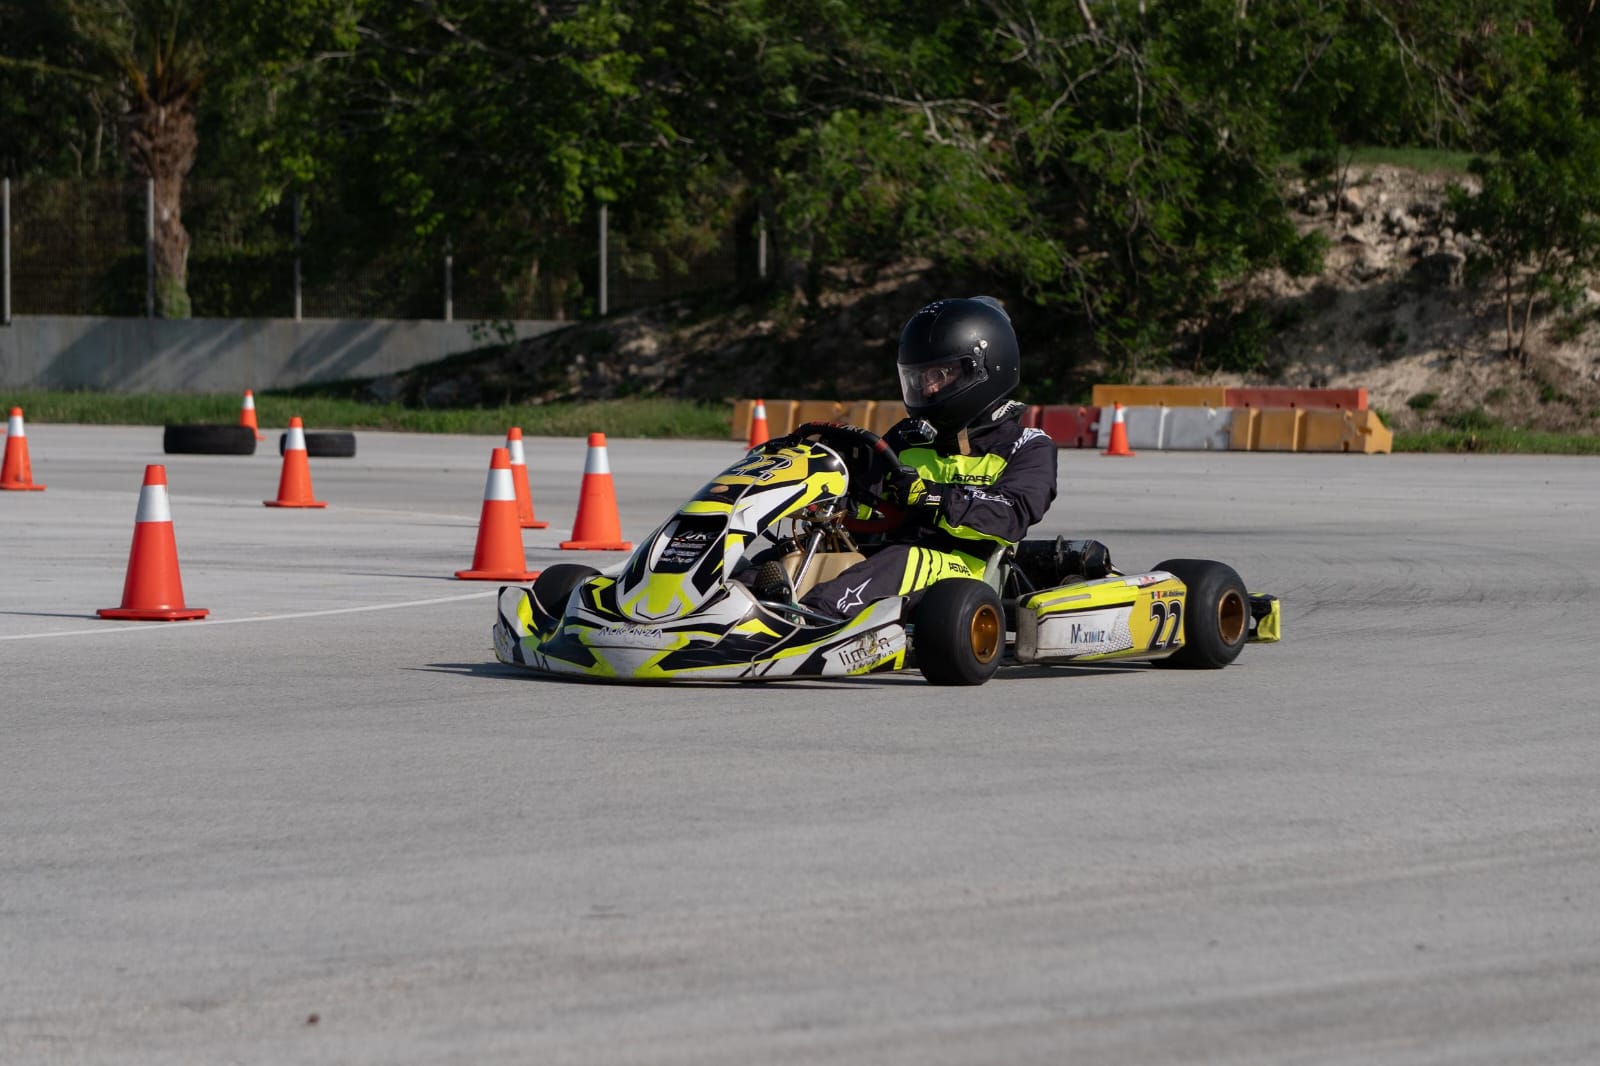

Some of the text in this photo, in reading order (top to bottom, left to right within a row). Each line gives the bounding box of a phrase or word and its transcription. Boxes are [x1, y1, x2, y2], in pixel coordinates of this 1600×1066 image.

[731, 455, 793, 482] 22
[598, 624, 663, 639] ALKNZA
[1145, 599, 1182, 650] 22
[838, 637, 891, 666] limn
